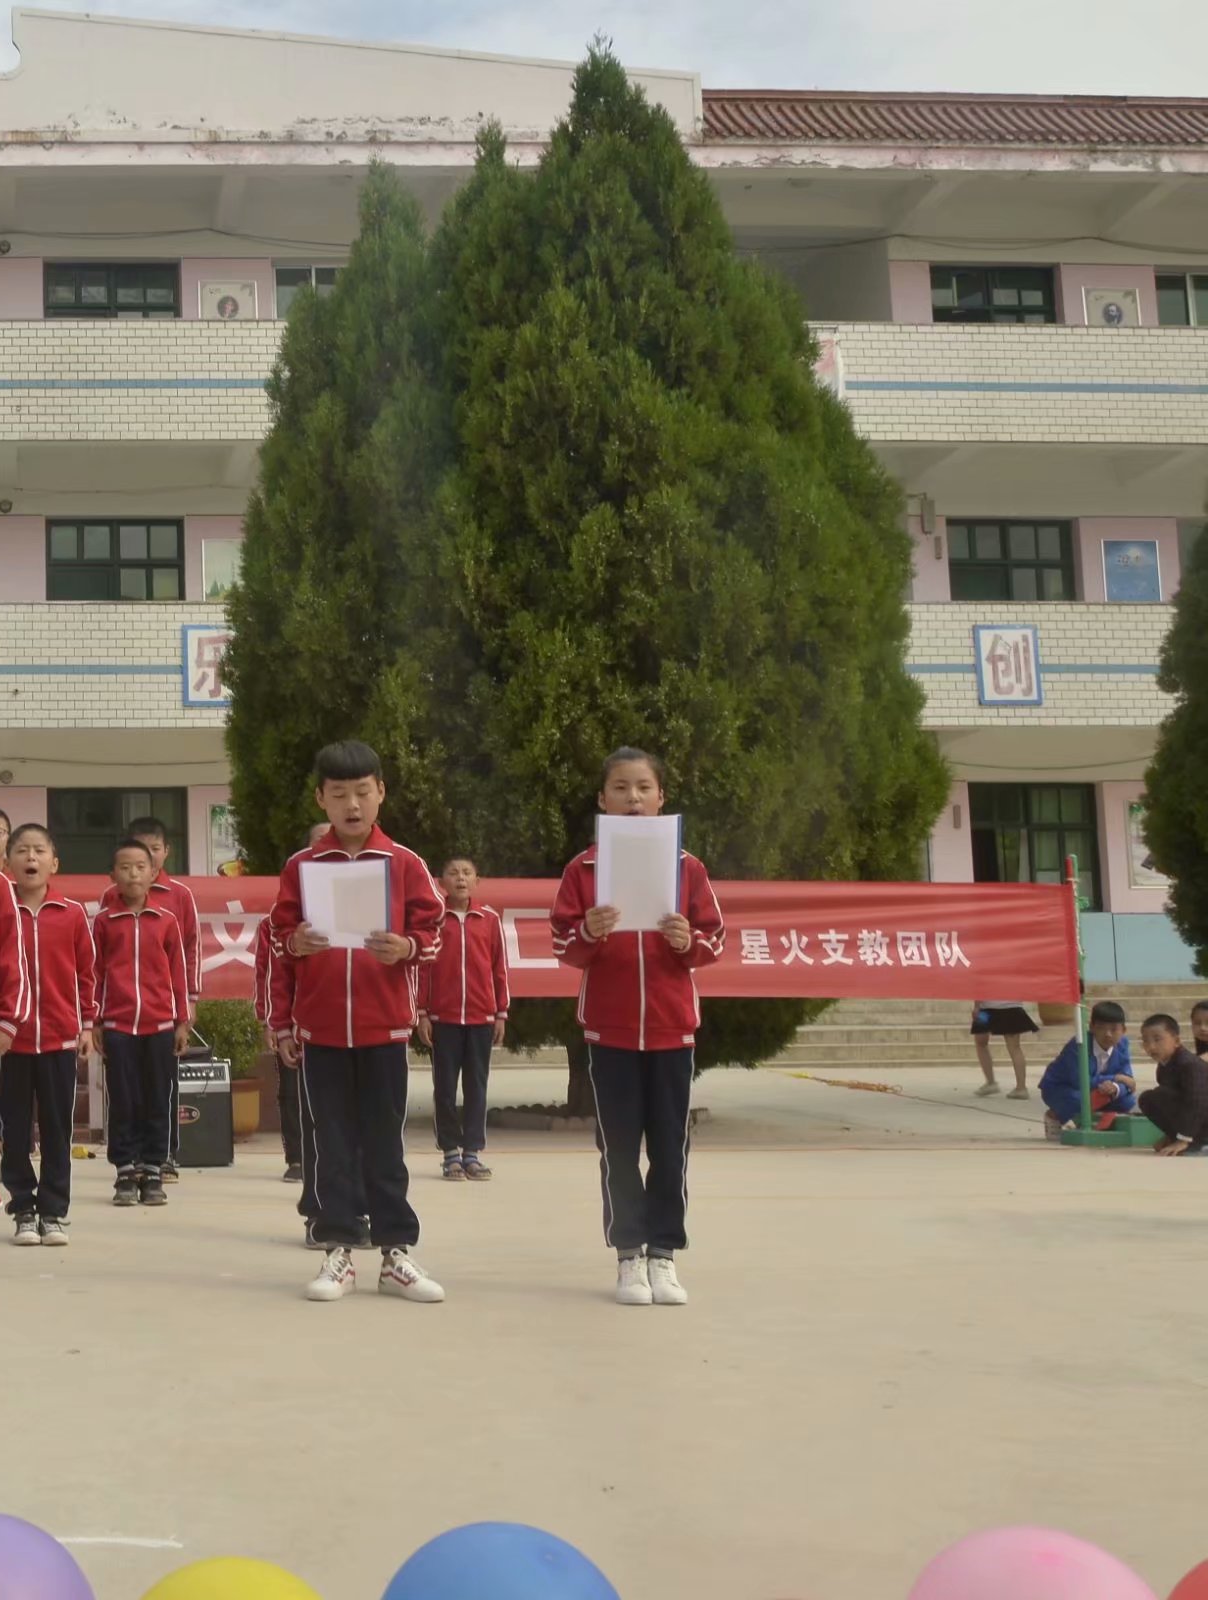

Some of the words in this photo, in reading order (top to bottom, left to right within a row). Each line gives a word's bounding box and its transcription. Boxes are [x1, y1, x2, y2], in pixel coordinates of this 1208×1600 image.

[986, 634, 1033, 697] 创
[198, 900, 262, 974] 文
[740, 928, 971, 968] 星火支教团队
